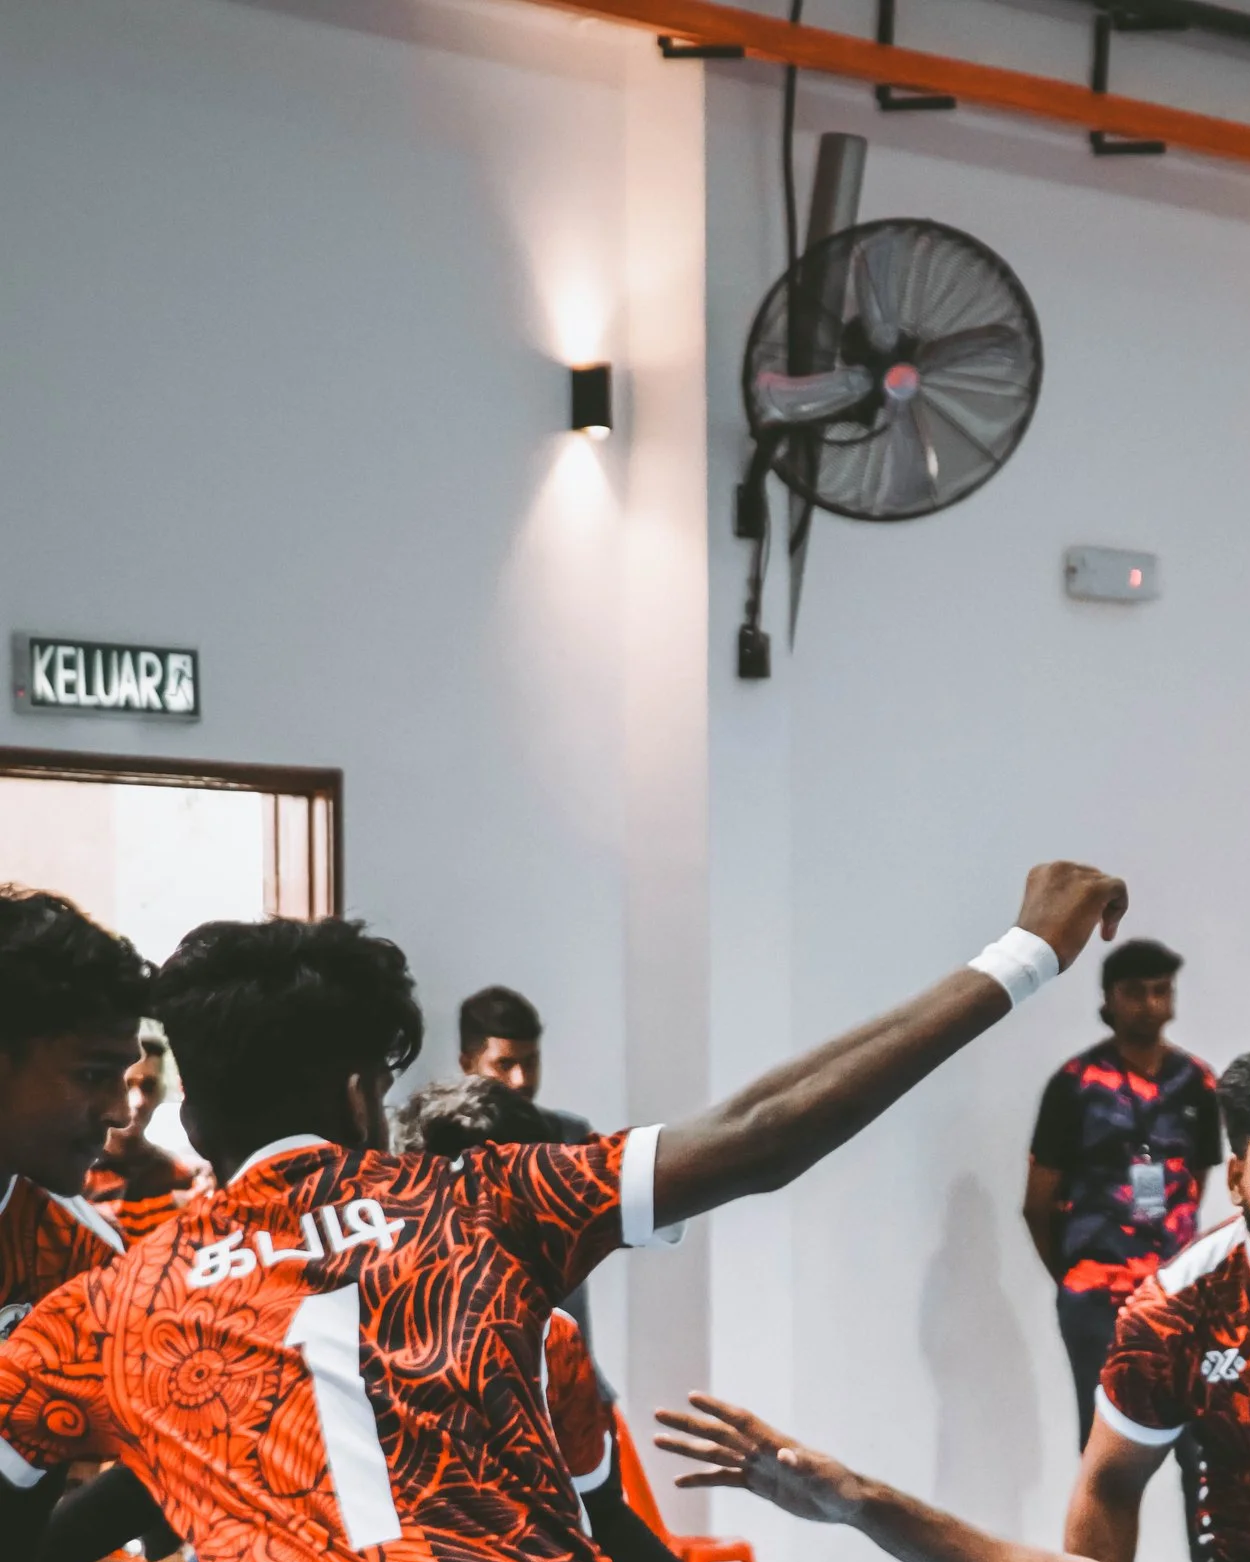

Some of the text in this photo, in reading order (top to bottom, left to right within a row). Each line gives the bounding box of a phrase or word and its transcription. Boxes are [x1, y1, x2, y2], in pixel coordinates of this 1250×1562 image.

[32, 644, 164, 710] KELUAR
[187, 1194, 406, 1288] கபடி
[283, 1282, 403, 1552] 1
